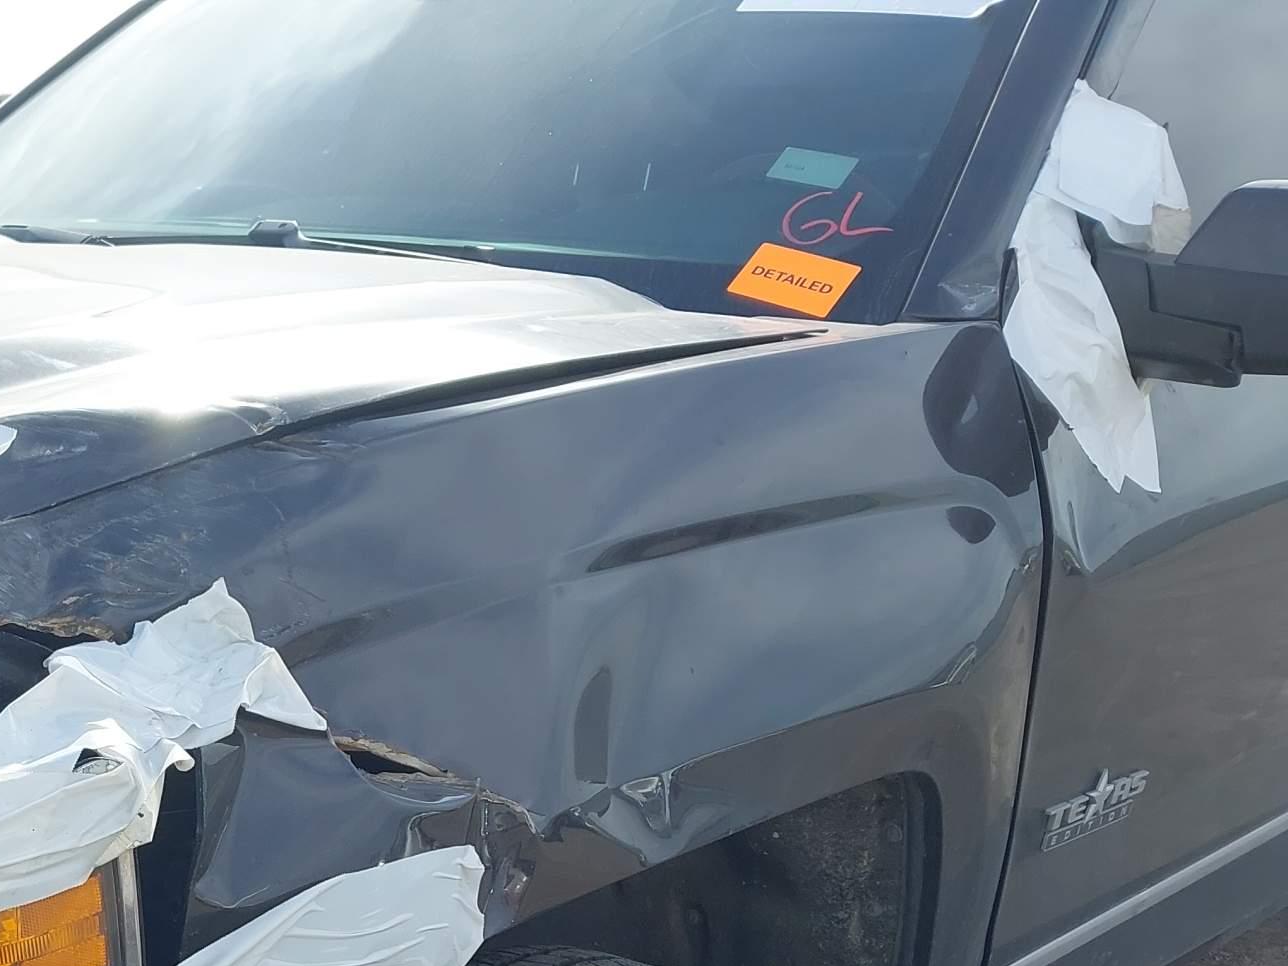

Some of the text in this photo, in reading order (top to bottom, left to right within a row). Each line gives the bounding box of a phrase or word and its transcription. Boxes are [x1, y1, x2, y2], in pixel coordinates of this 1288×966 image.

[751, 265, 833, 294] DETAILED
[1045, 768, 1150, 830] TEXAS
[1050, 806, 1130, 846] EDITION
